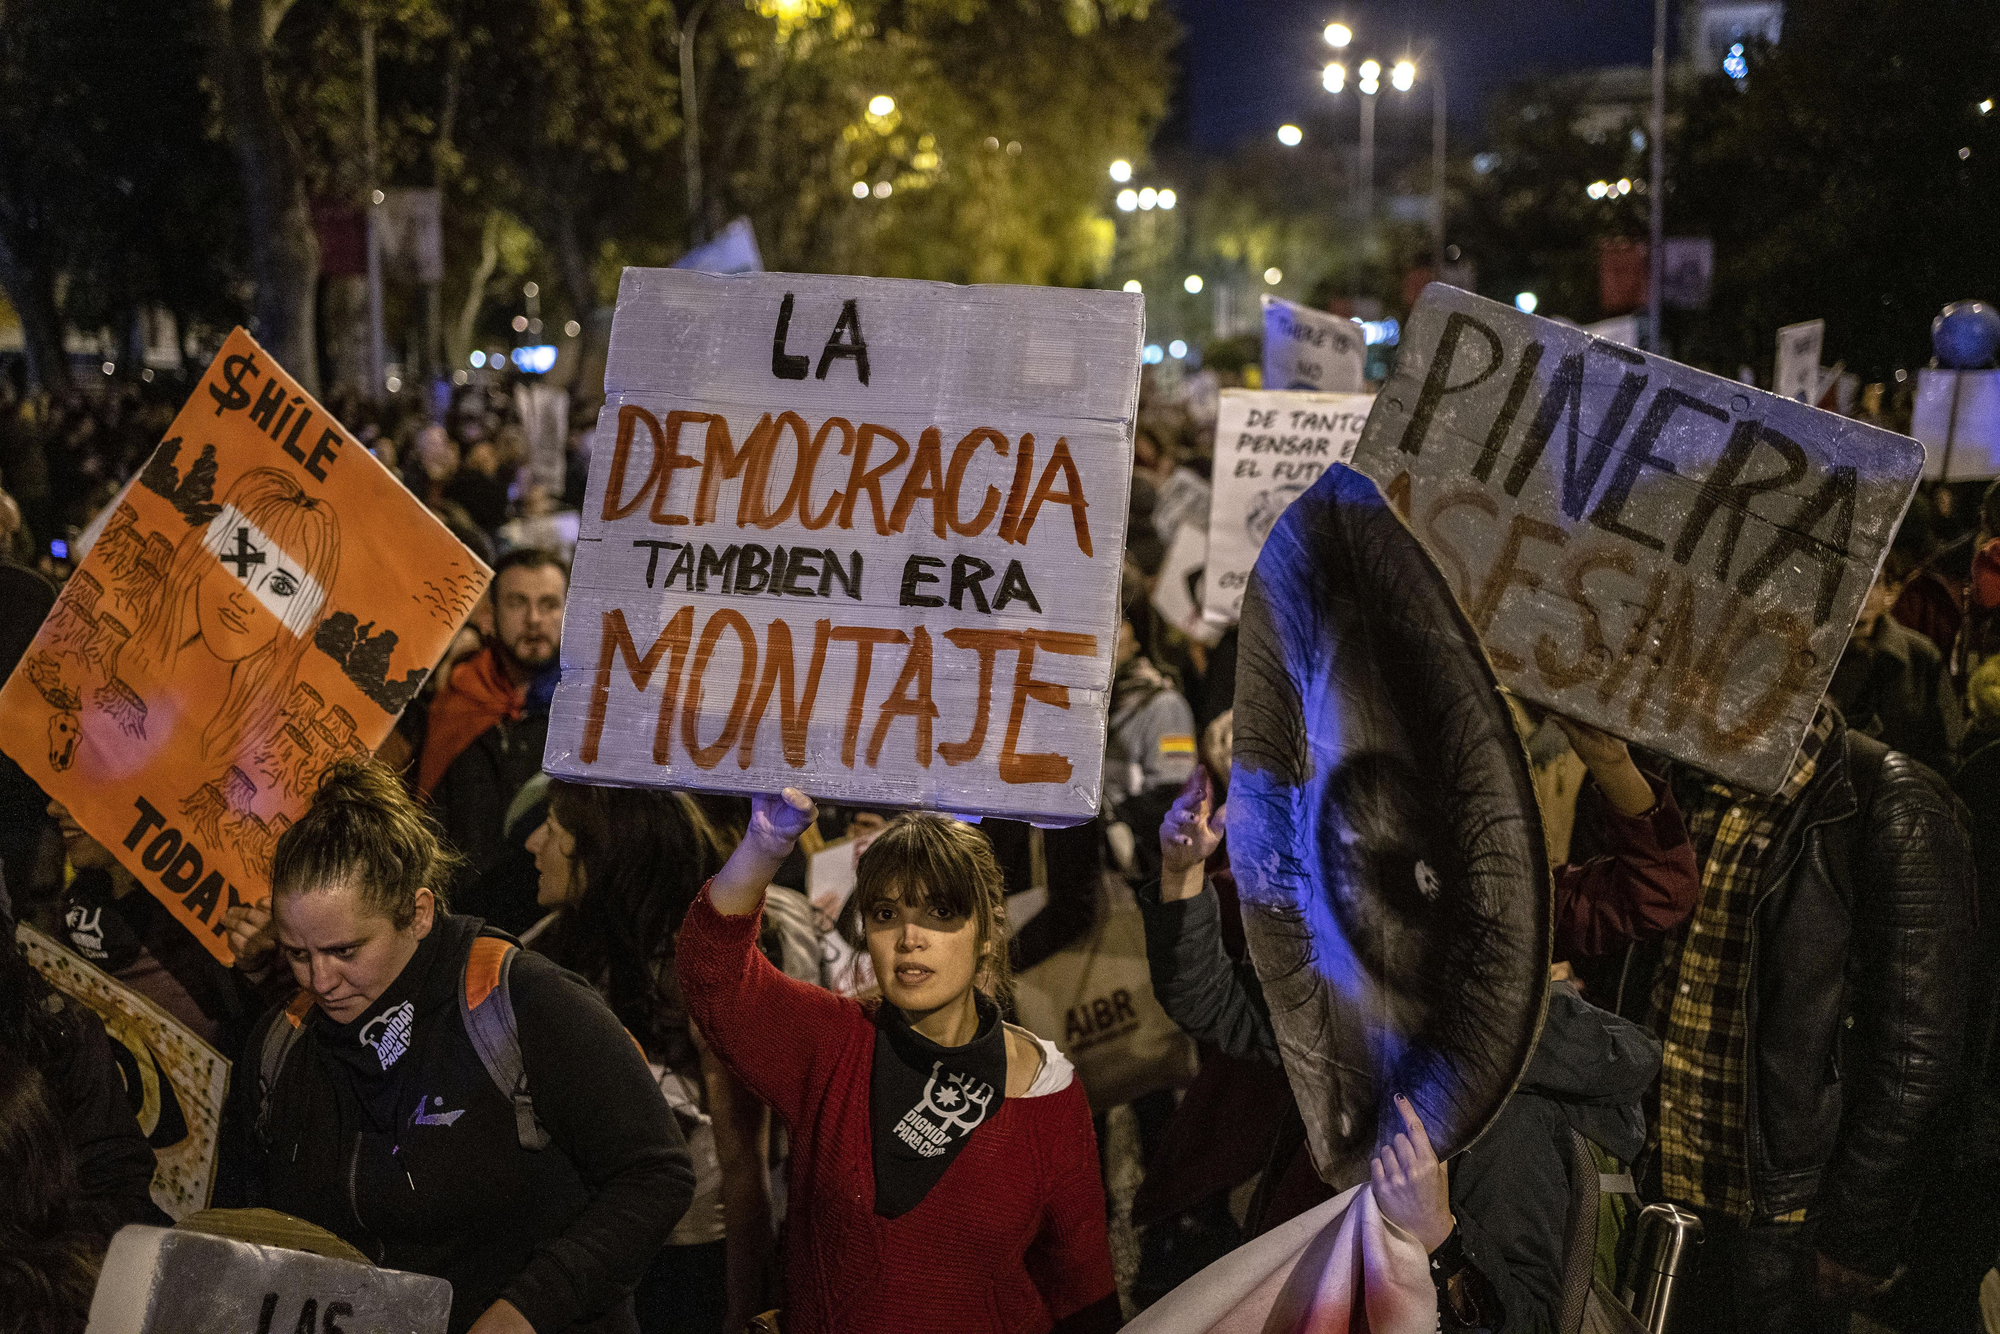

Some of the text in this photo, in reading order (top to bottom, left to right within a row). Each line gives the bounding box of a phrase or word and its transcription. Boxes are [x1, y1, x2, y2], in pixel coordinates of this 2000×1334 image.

[772, 292, 870, 386] LA
[1236, 432, 1329, 456] PENSAR
[1246, 408, 1367, 433] DE TANTO
[600, 404, 1094, 558] DEMOCRACIA
[1234, 459, 1262, 478] EL
[633, 540, 1043, 614] TAMBIEN ERA
[579, 606, 1098, 785] MONTAJE
